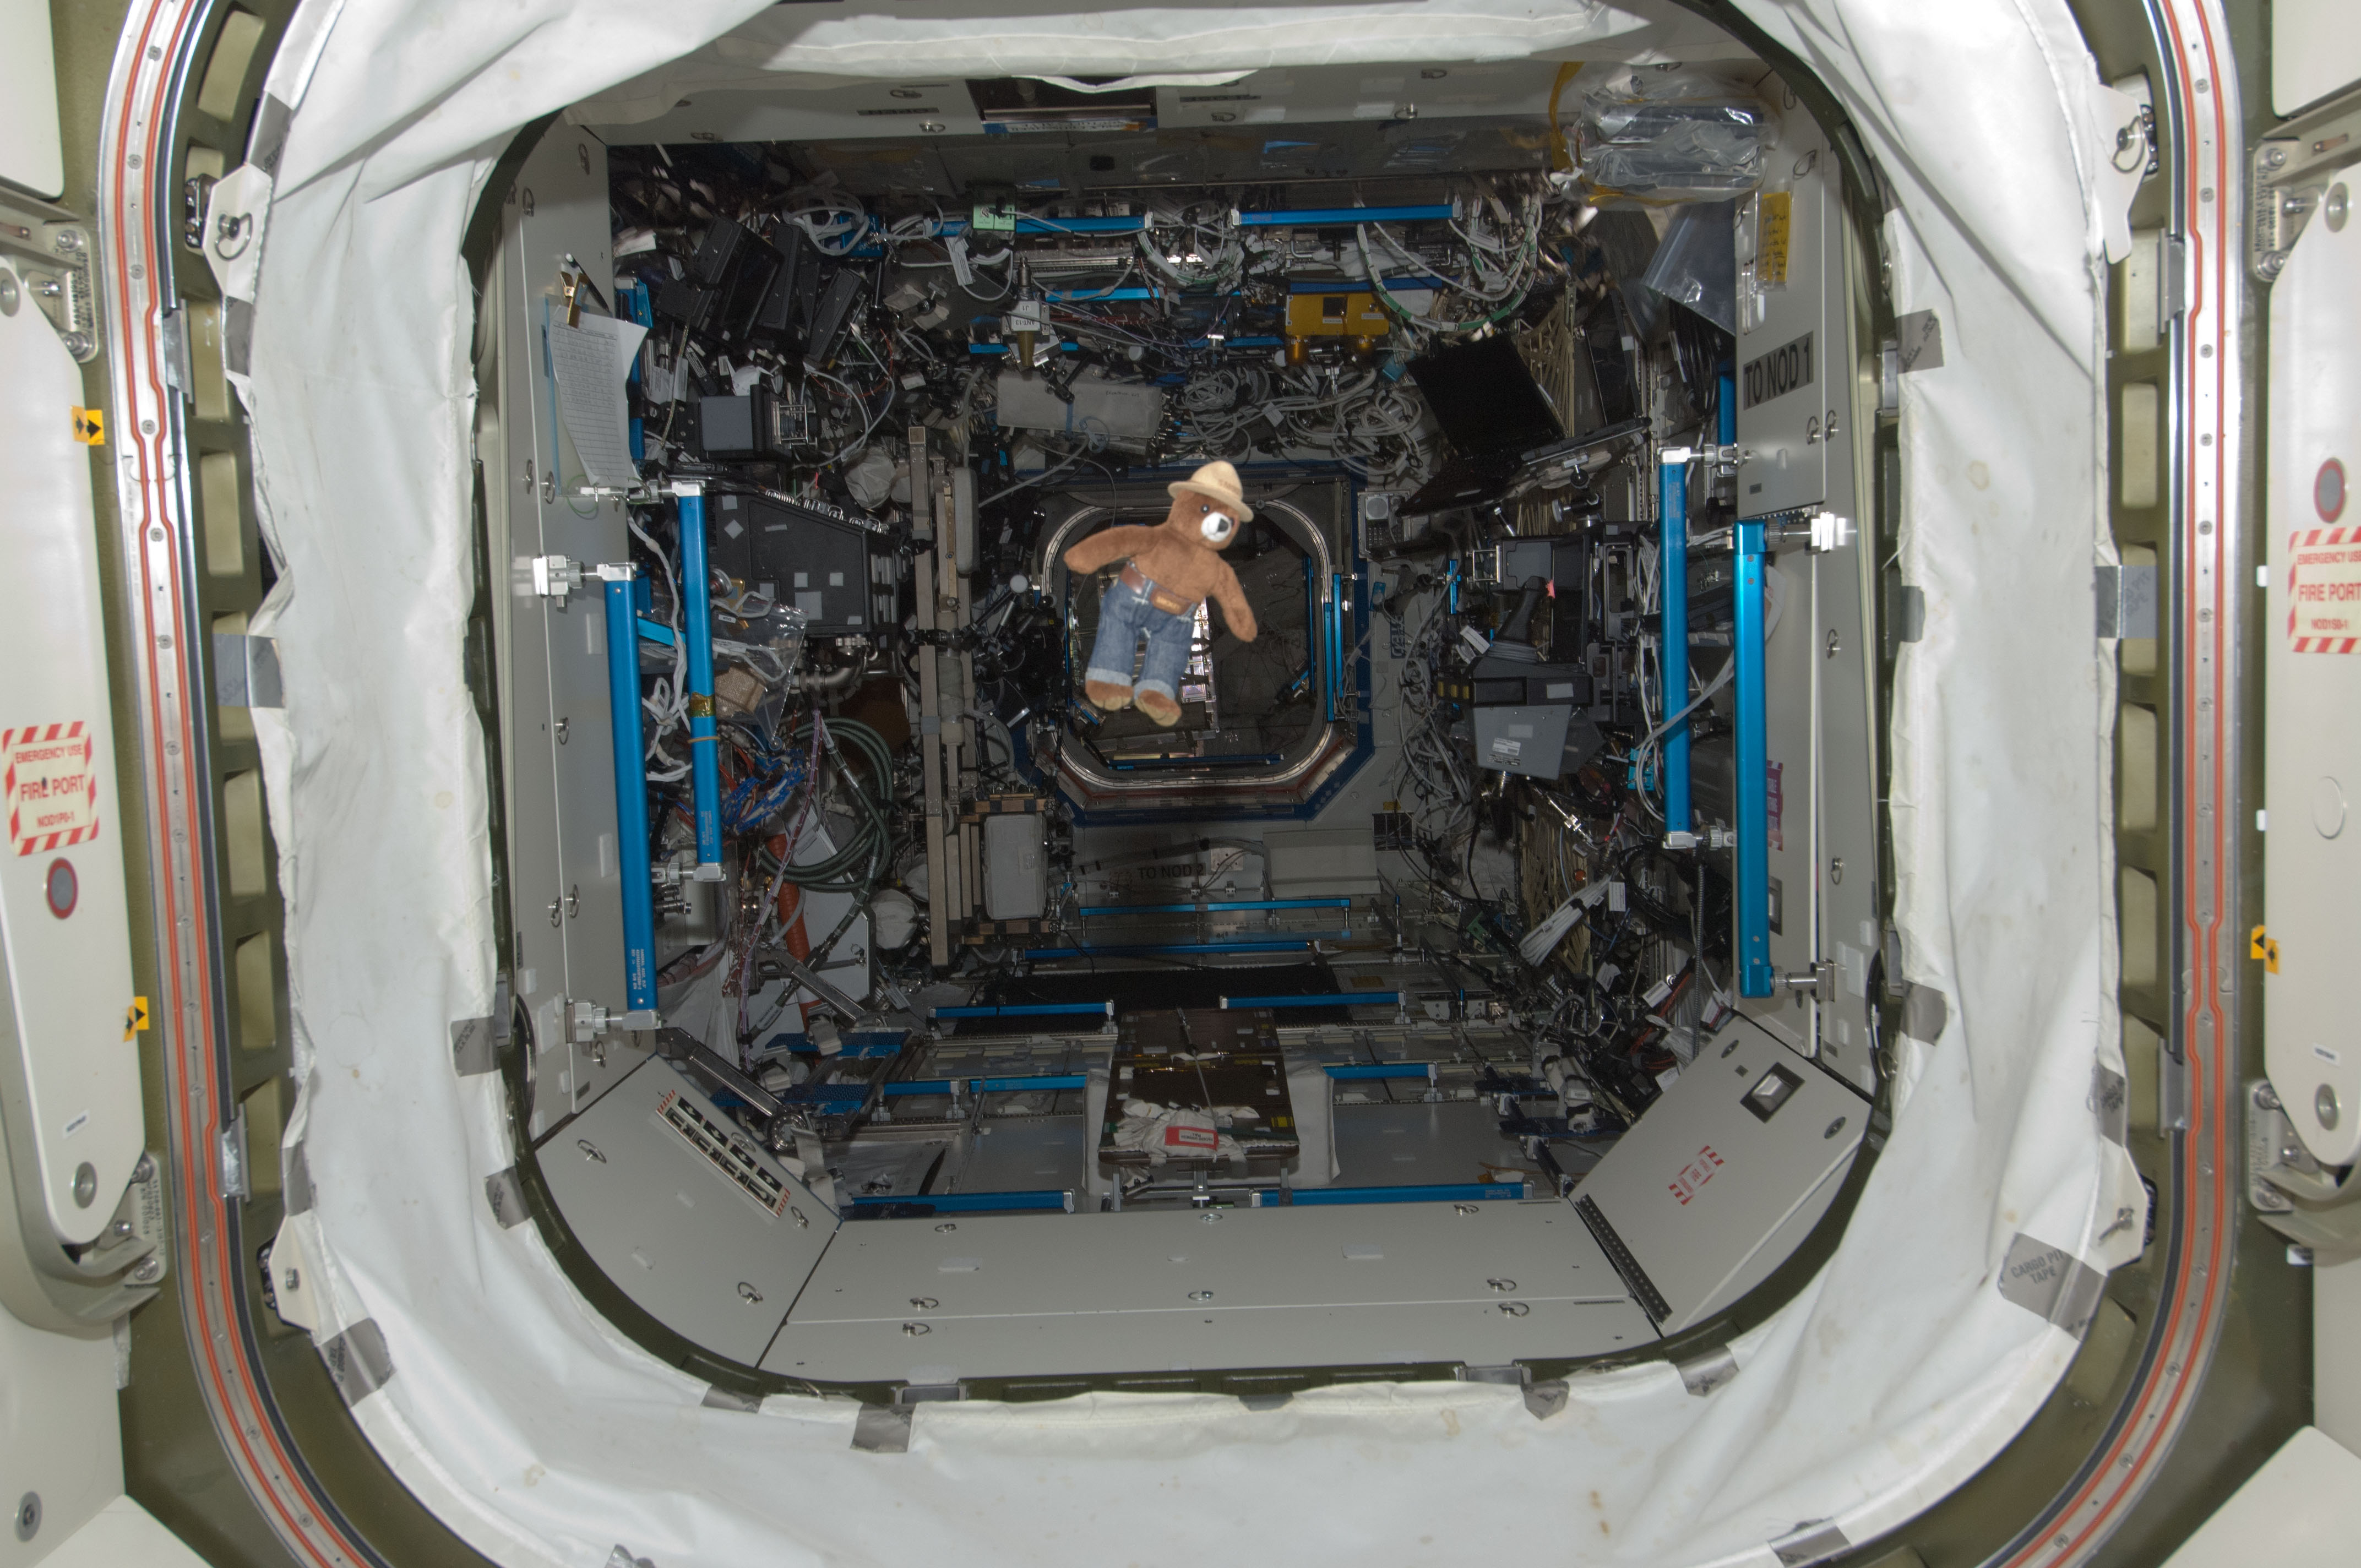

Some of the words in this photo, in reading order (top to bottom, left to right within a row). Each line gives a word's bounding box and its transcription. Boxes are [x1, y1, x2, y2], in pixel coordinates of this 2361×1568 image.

[1744, 361, 1763, 407] TO
[1767, 344, 1798, 396] NOD
[1804, 337, 1811, 383] 1
[2297, 552, 2346, 565] EMERGENCY
[2298, 582, 2325, 601] FIRE
[2329, 582, 2361, 601] PORT
[15, 746, 66, 764] EMERGENCY
[67, 744, 84, 756] USE
[20, 778, 48, 803] FIRE
[52, 774, 85, 797] PORT
[1138, 867, 1156, 879] TO
[1161, 864, 1192, 878] NOD
[2010, 1255, 2045, 1278] CARGO
[2029, 1265, 2057, 1284] TAPE
